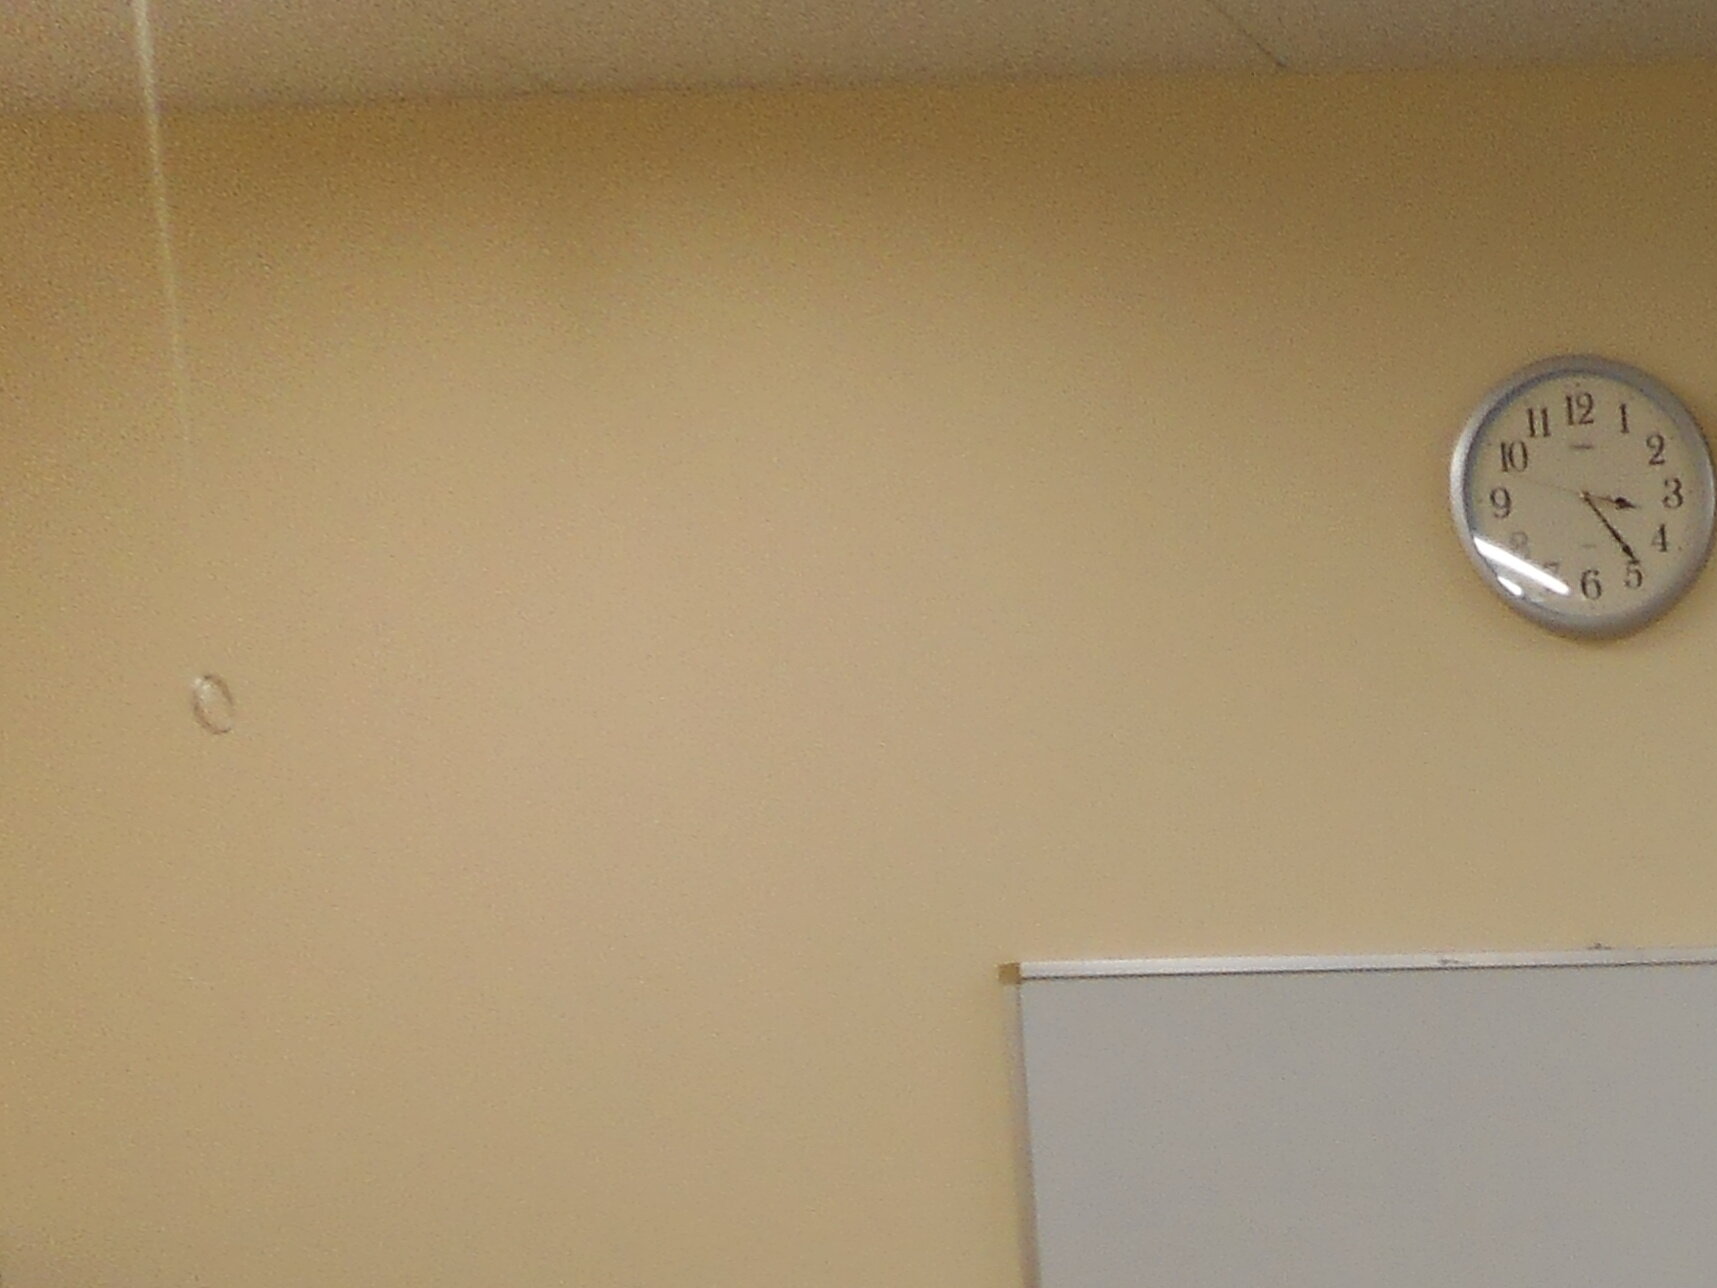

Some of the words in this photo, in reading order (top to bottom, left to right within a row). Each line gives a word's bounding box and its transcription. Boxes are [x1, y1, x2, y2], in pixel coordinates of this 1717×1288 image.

[1526, 407, 1550, 438] 11
[1564, 392, 1595, 426] 12
[1618, 404, 1631, 434] 1
[1500, 440, 1529, 473] 10
[1646, 434, 1666, 465] 2
[1489, 487, 1512, 519] 9
[1663, 478, 1684, 509] 3
[1651, 524, 1669, 552] 4
[1580, 569, 1602, 600] 6
[1624, 567, 1644, 590] 5
